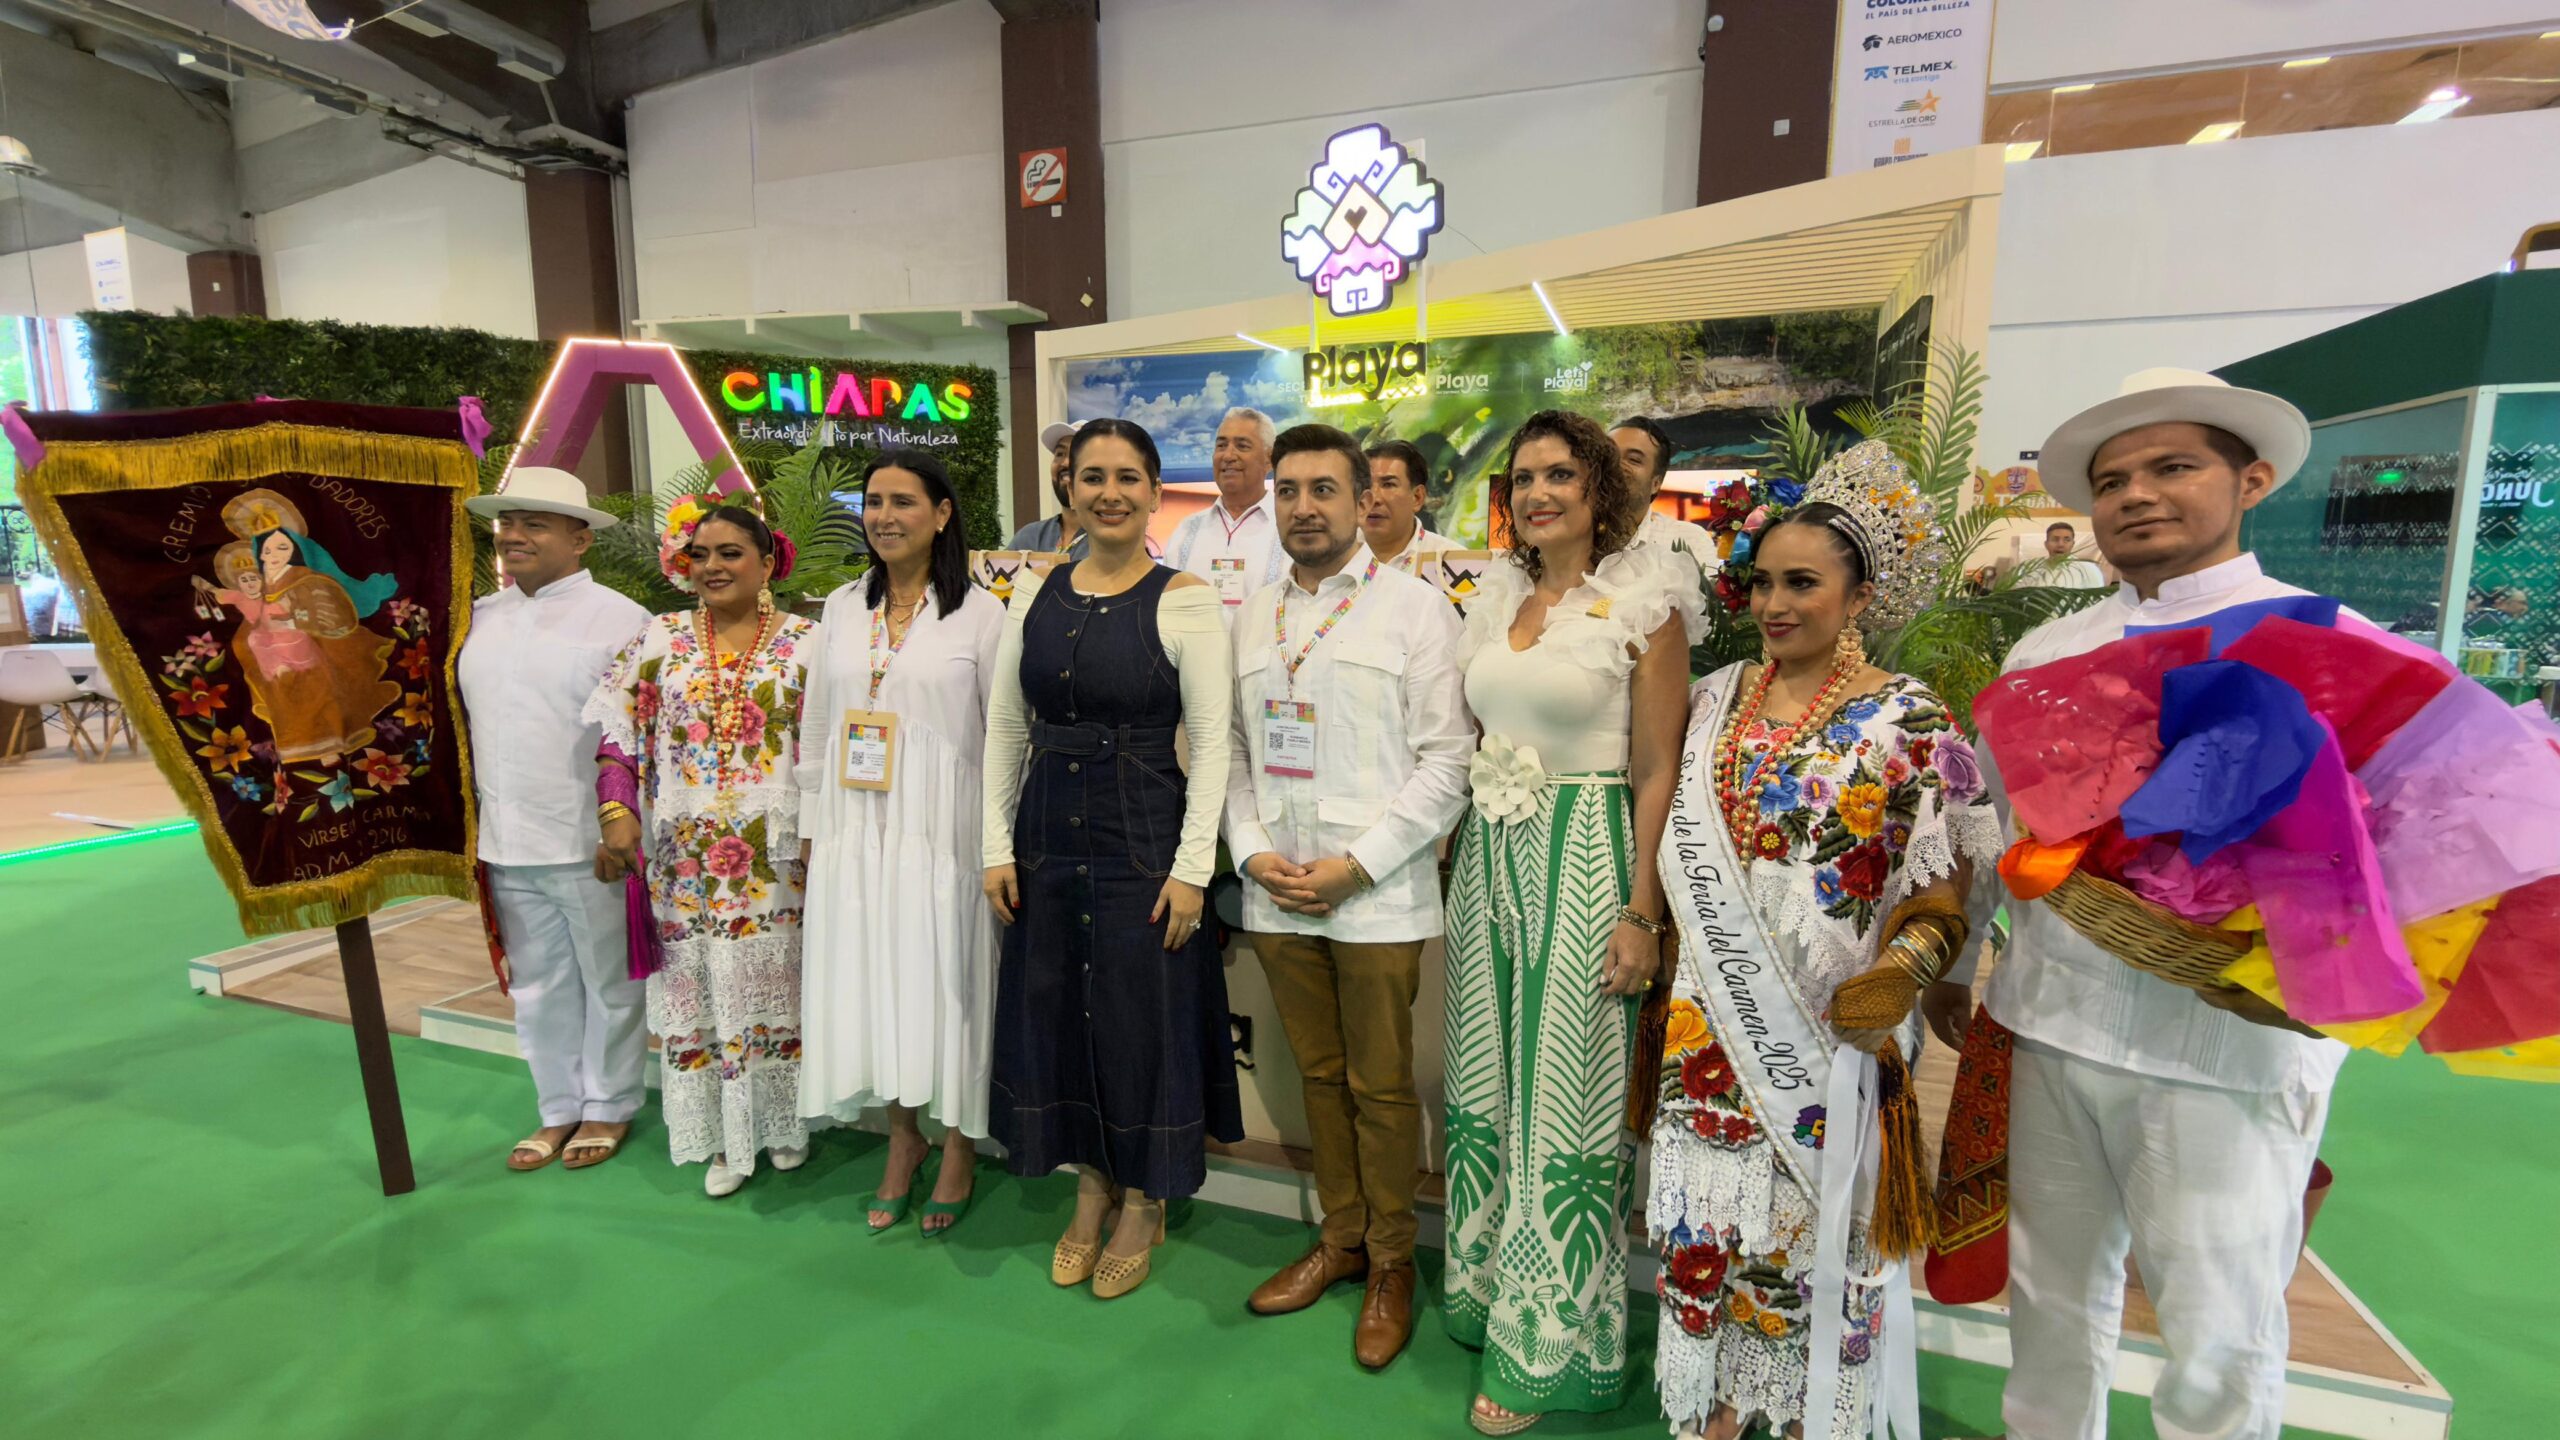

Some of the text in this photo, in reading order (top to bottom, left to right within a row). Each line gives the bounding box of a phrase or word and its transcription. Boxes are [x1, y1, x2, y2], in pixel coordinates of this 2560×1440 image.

[1931, 1, 1970, 12] BELLEZA
[1887, 28, 1962, 45] AEROMEXICO
[1893, 61, 1953, 75] TELMEX
[1868, 118, 1905, 128] ESTRELLA
[1906, 116, 1918, 124] DE
[1918, 114, 1937, 123] ORO
[1303, 341, 1427, 401] Playa
[1436, 373, 1489, 394] Playa
[850, 429, 875, 448] por
[878, 426, 959, 446] Naturaleza
[1671, 814, 1701, 839] de
[1676, 842, 1707, 864] la
[1683, 865, 1727, 922] Feria
[1702, 925, 1749, 956] del
[1717, 958, 1769, 1039] Carmen
[1751, 1040, 1815, 1090] 2025
